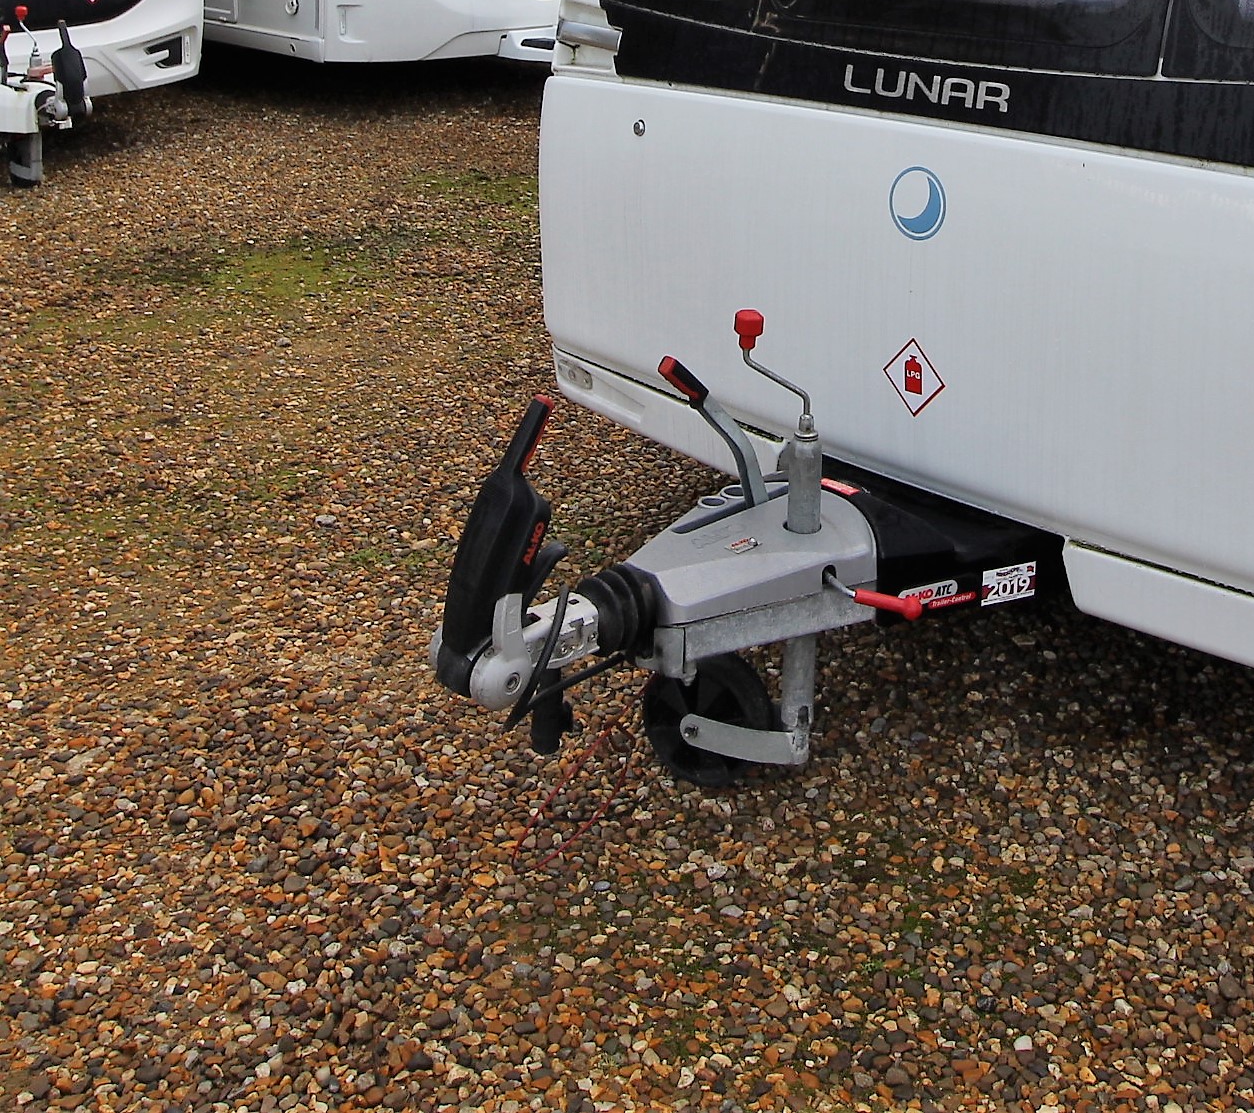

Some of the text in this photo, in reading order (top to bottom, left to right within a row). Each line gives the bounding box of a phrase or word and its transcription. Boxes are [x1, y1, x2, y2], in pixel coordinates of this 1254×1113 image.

[843, 63, 1012, 114] LUNAR
[906, 369, 921, 380] LPG
[934, 583, 953, 598] ATC
[986, 576, 1031, 601] 2019
[932, 593, 973, 608] Trailer-Control
